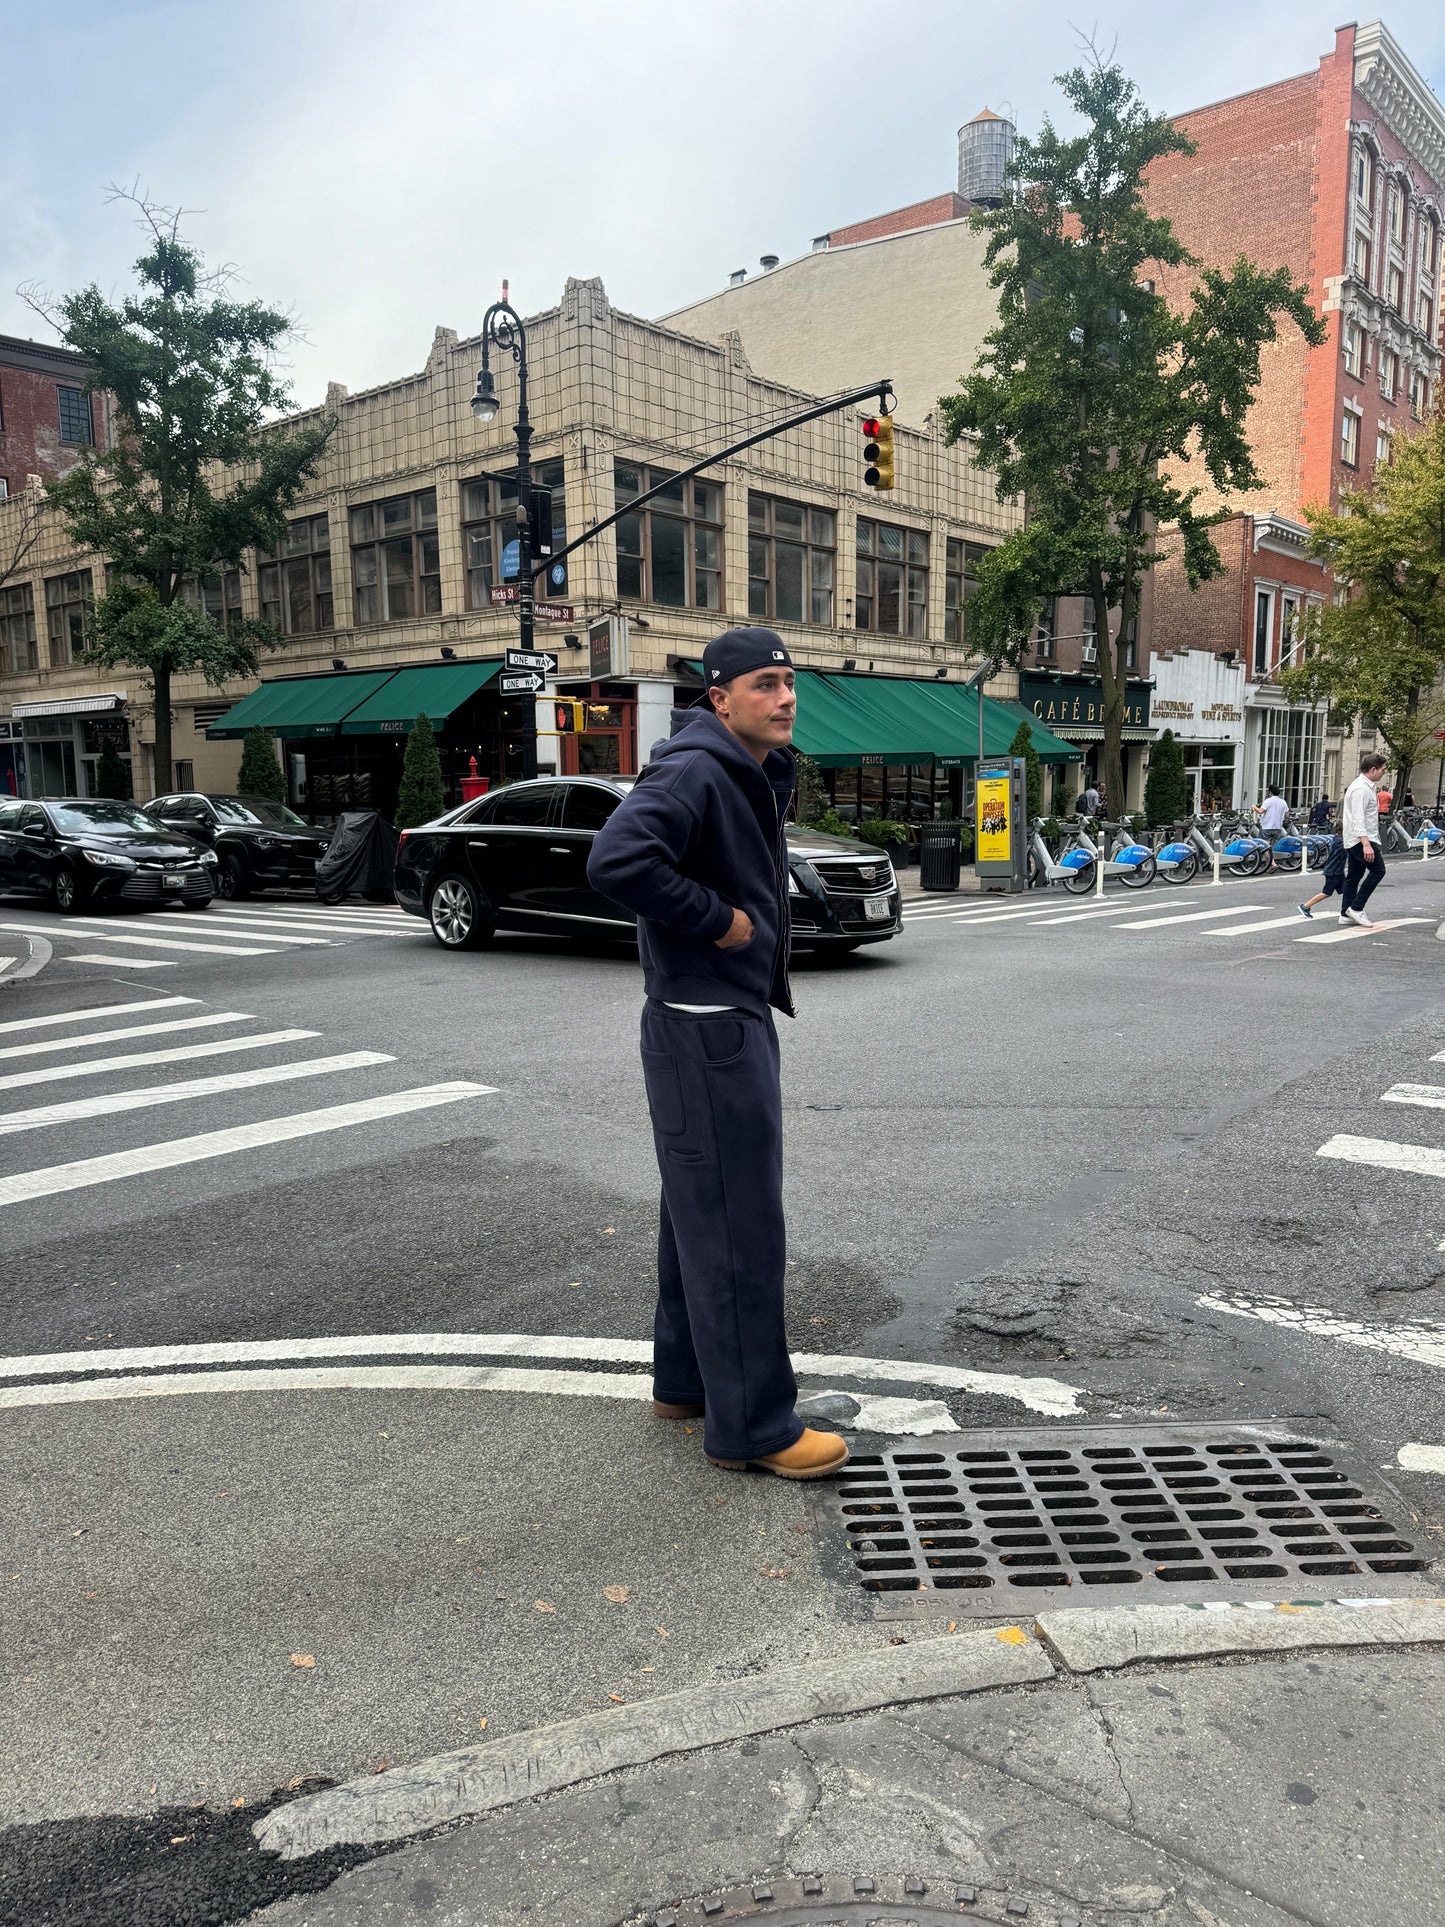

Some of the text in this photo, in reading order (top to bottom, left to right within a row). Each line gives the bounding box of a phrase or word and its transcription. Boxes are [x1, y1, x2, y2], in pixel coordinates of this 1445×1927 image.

[491, 588, 514, 600] Hicks St
[534, 604, 570, 620] Montague St
[592, 634, 609, 657] FELICE
[513, 655, 551, 668] ONE WAY
[506, 677, 539, 689] ONE WAY
[1033, 697, 1142, 724] CAFÉ BRME
[380, 722, 404, 731] FELICE
[862, 755, 884, 764] FELICE
